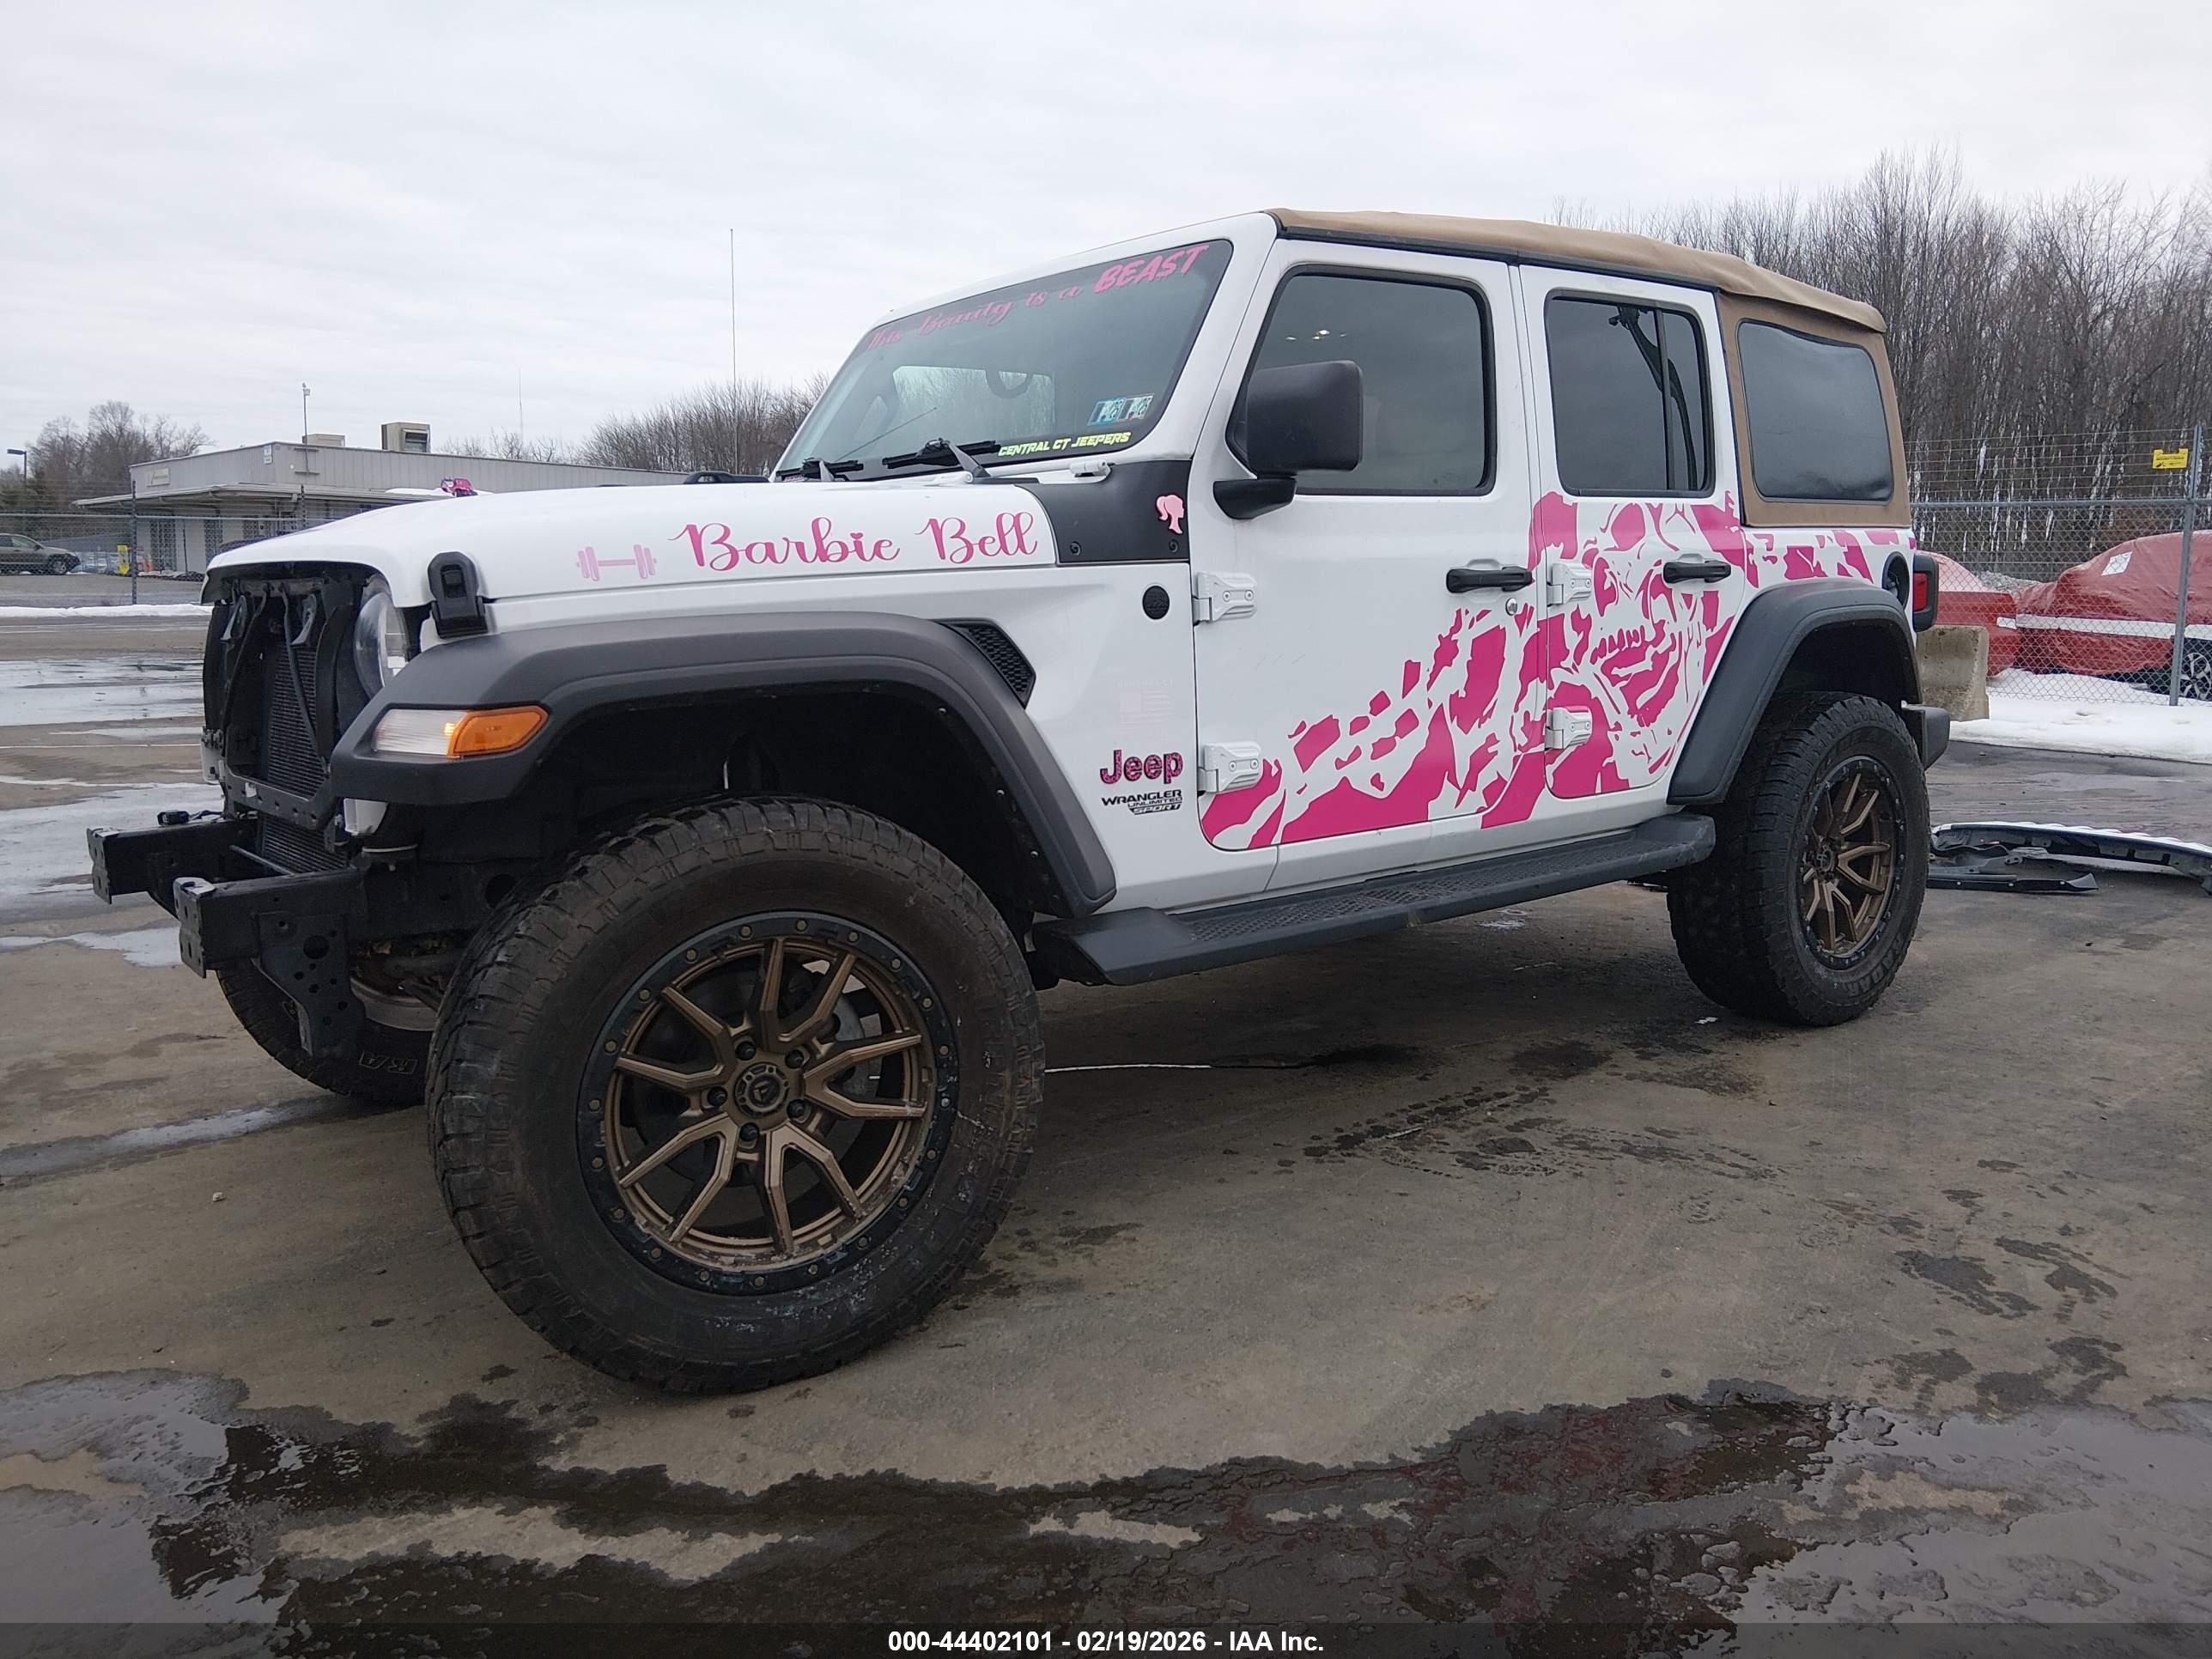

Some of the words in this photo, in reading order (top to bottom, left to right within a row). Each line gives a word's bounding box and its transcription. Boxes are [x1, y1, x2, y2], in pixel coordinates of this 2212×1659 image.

[1059, 286, 1083, 299] a
[1093, 244, 1210, 295] BEAST
[998, 441, 1050, 457] CENTRAL
[1052, 438, 1072, 451] CT
[1071, 431, 1132, 447] JEEPERS
[666, 516, 901, 572] Barbie
[914, 511, 1038, 564] Bell
[1099, 749, 1183, 785] Jeep
[1101, 789, 1182, 806] WRANGLER
[1127, 797, 1183, 808] UNLIMITED
[1132, 804, 1181, 813] SPORT
